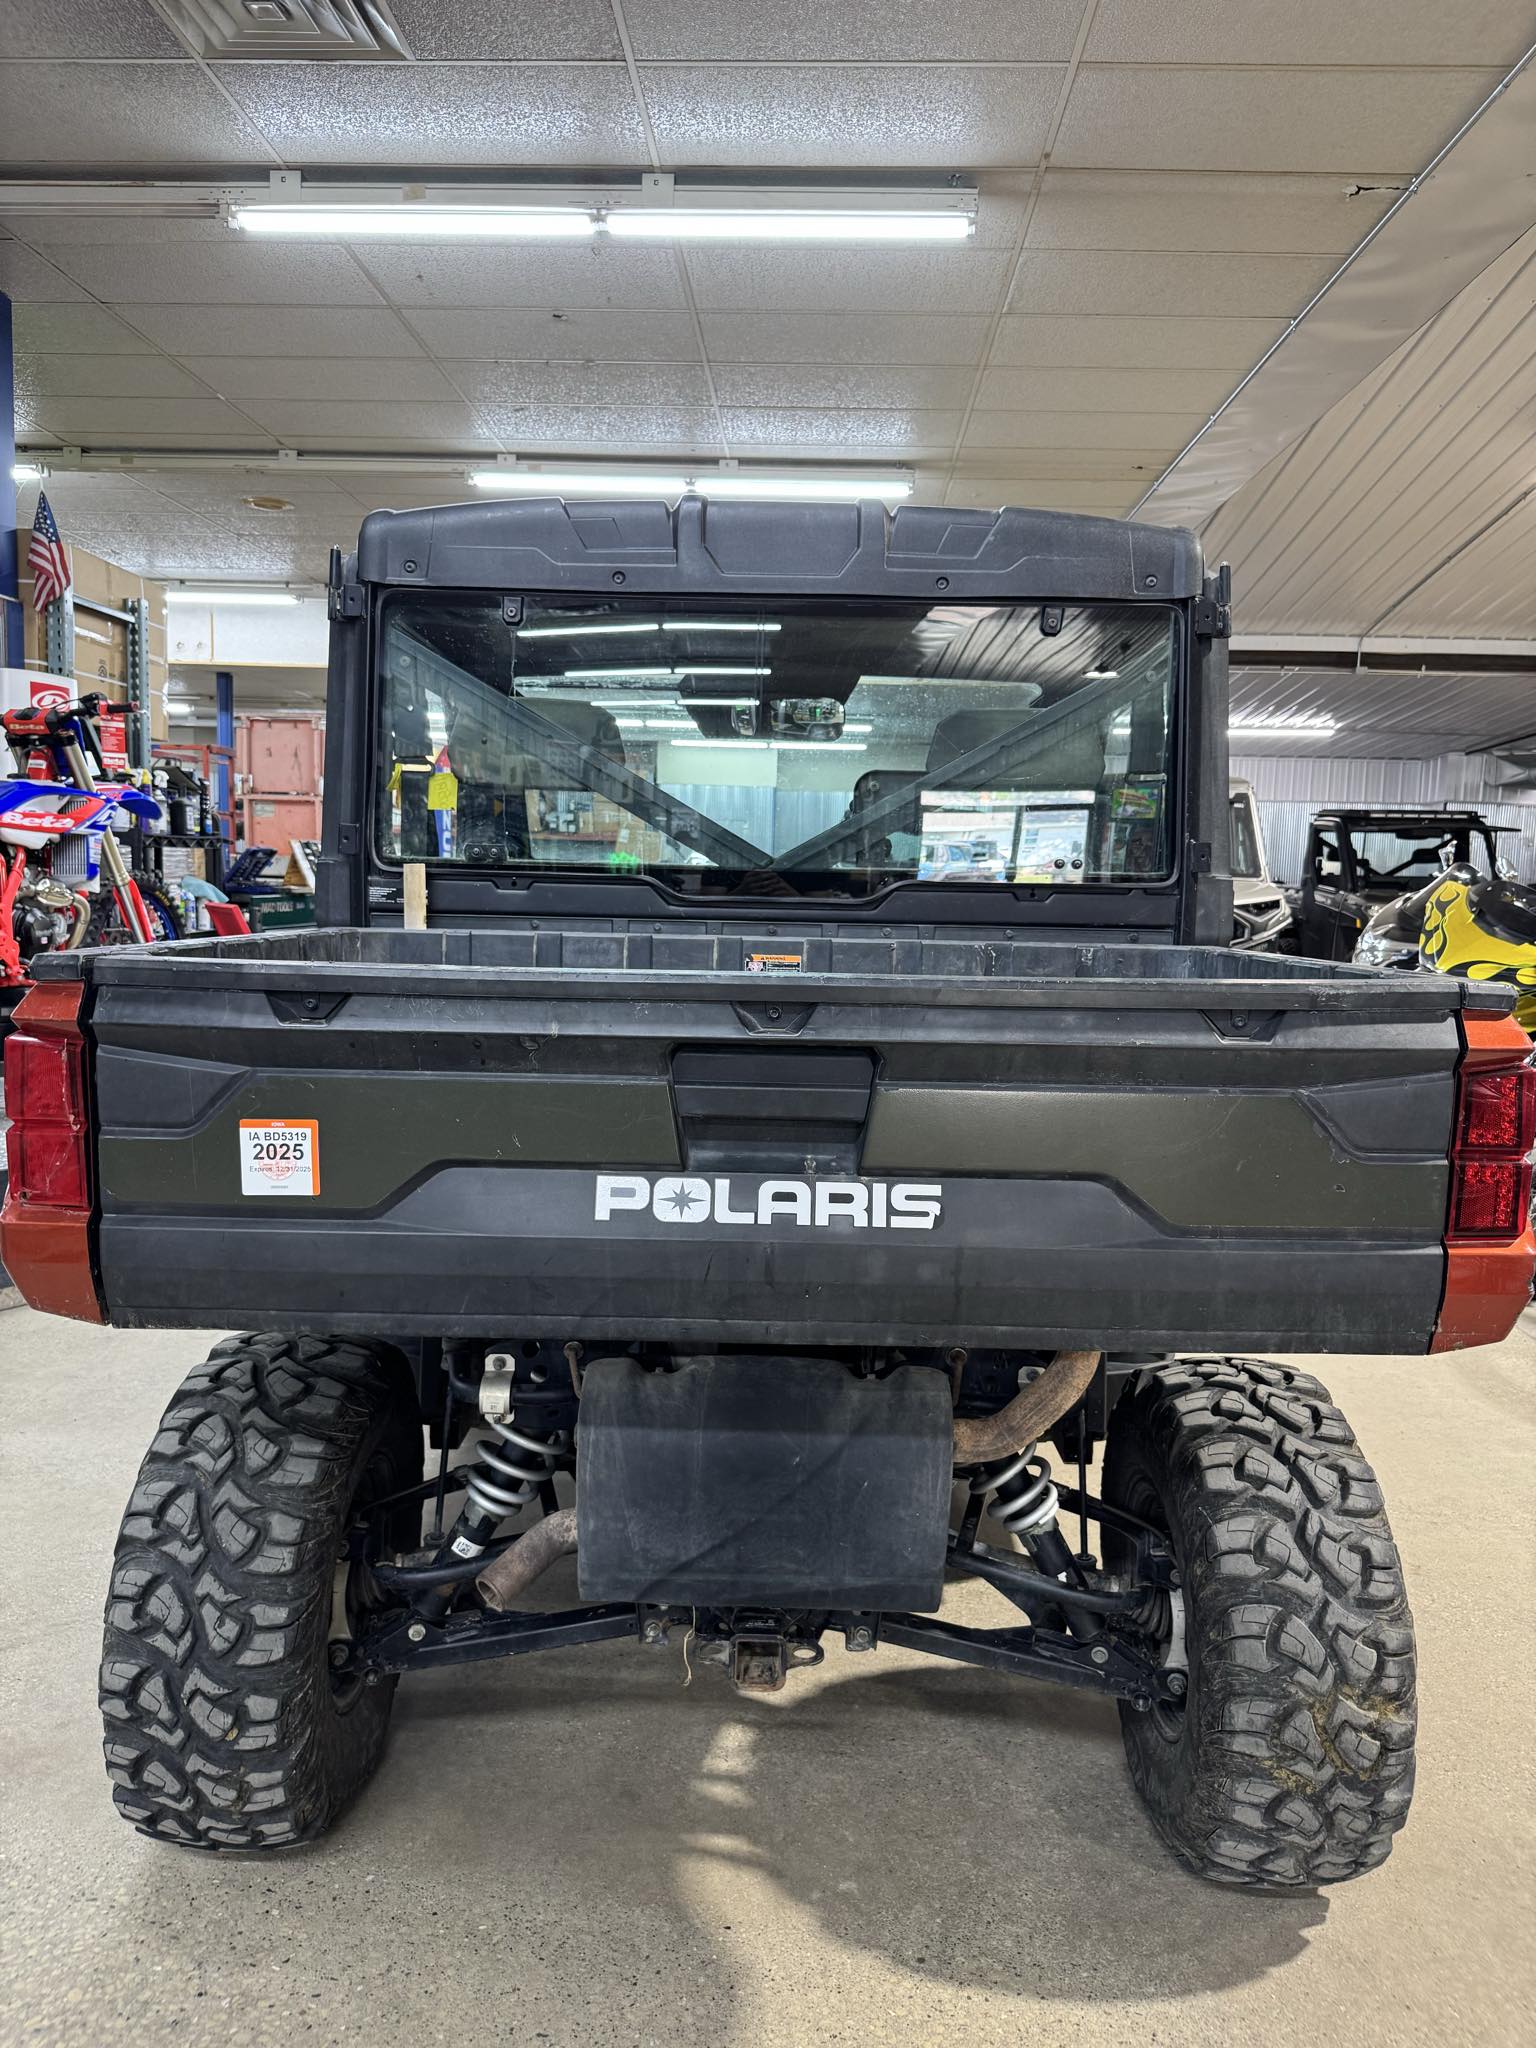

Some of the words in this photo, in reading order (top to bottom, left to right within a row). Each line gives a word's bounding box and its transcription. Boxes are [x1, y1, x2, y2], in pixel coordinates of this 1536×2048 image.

[1, 811, 75, 828] Beta
[249, 1132, 260, 1141] IA
[264, 1131, 307, 1141] BD5319
[253, 1143, 304, 1160] 2025
[594, 1175, 942, 1230] POLARIS
